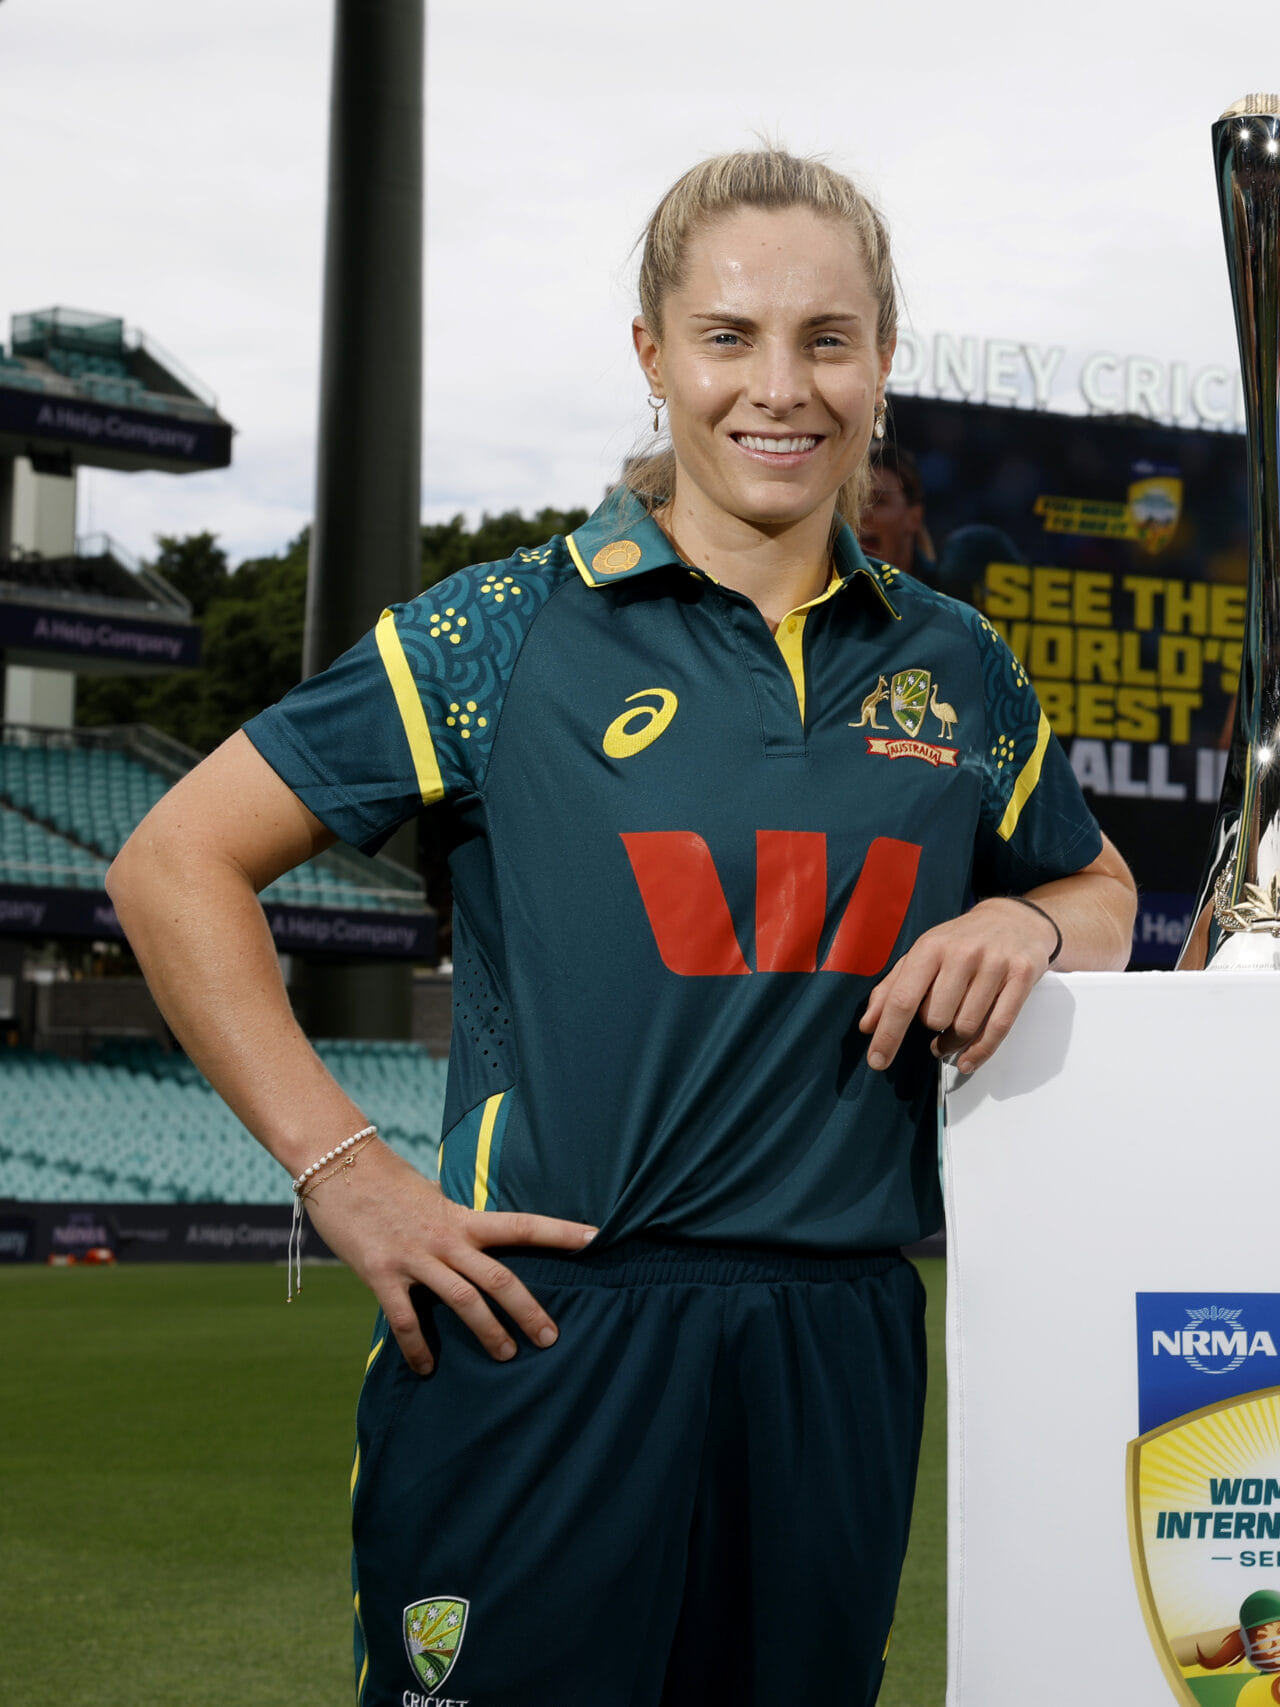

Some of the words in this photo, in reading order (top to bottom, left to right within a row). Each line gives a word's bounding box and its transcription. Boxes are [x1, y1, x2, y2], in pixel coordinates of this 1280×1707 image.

[887, 333, 1066, 405] DNEY
[36, 404, 53, 425] A
[56, 407, 100, 437] Help
[104, 415, 198, 455] Company
[985, 562, 1114, 627] SEE
[1122, 576, 1248, 638] THE
[34, 617, 50, 639] A
[51, 619, 95, 647] Help
[97, 625, 183, 660] Company
[1033, 681, 1203, 744] BEST
[889, 743, 940, 761] AUSTRALIA
[1069, 738, 1187, 800] ALL
[1196, 748, 1229, 802] I
[272, 914, 285, 935] A
[288, 916, 331, 945] Help
[332, 917, 418, 950] Company
[1142, 912, 1192, 945] Hel
[200, 1225, 234, 1249] Help
[1152, 1330, 1278, 1356] NRMA
